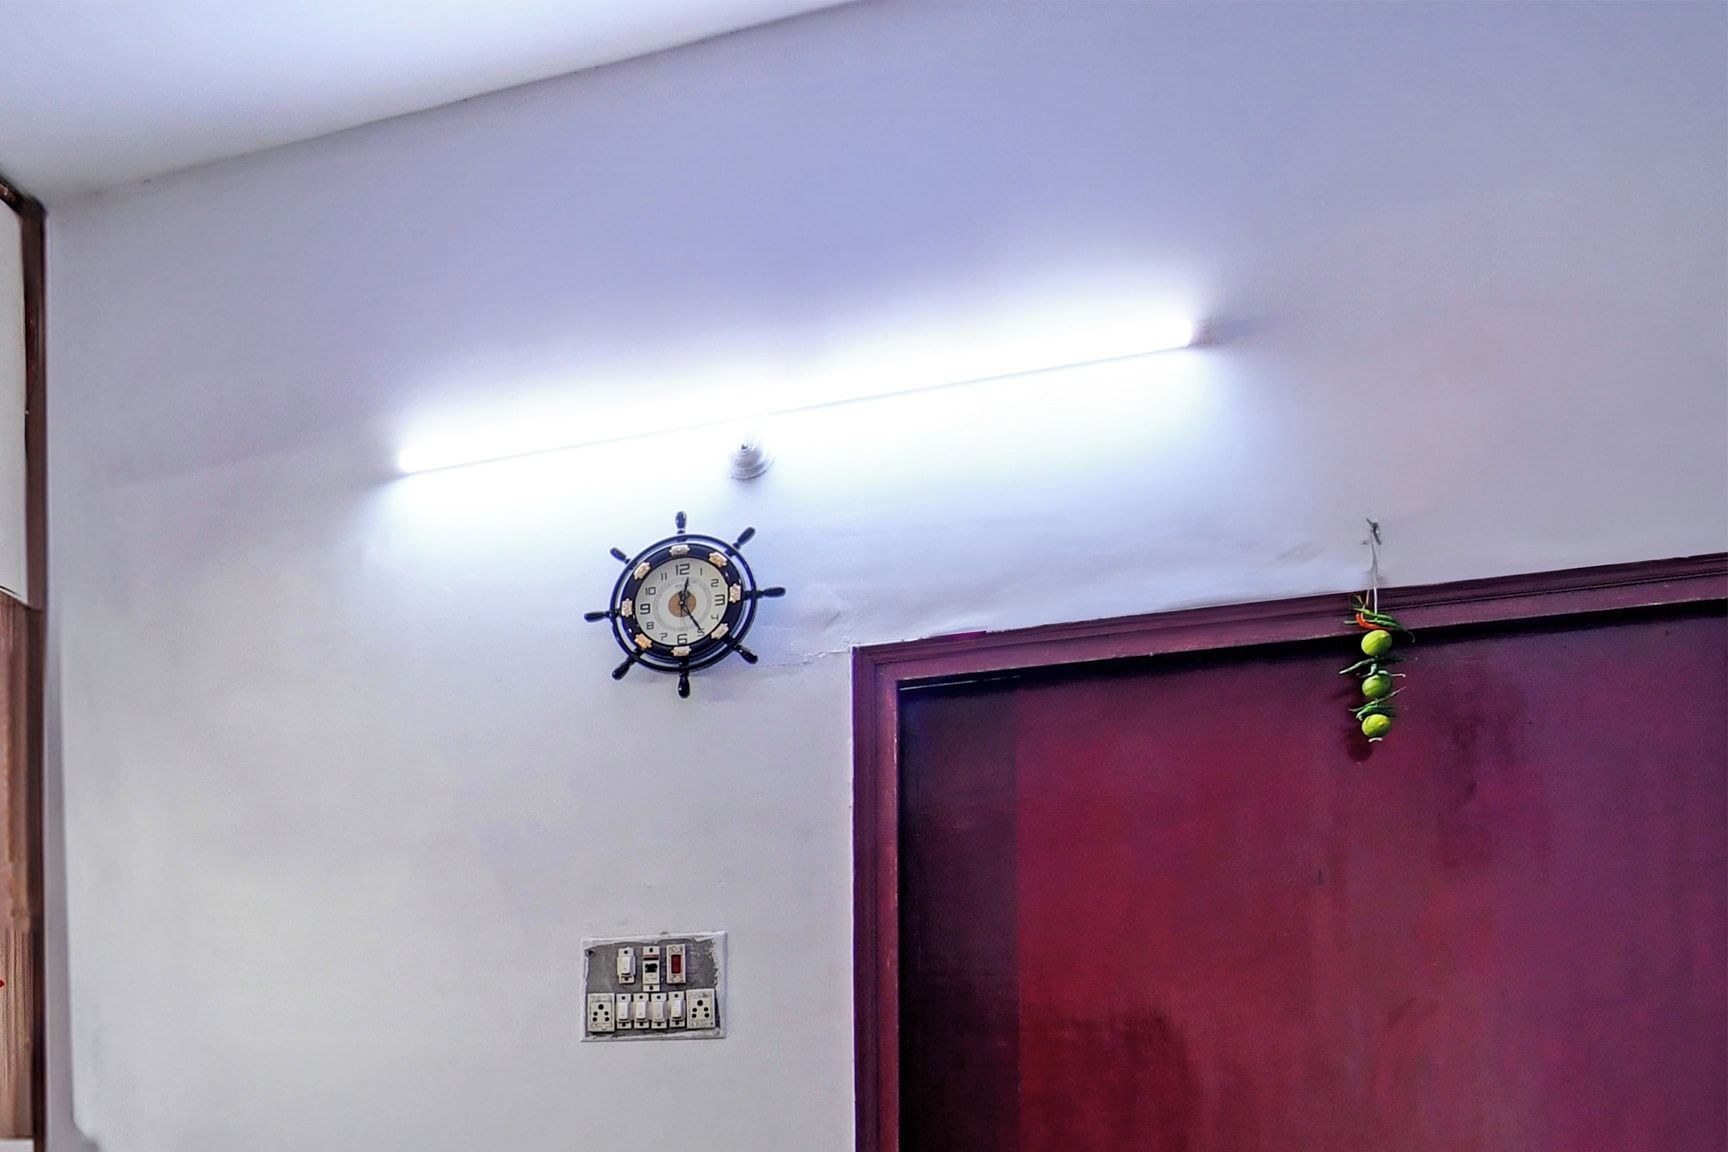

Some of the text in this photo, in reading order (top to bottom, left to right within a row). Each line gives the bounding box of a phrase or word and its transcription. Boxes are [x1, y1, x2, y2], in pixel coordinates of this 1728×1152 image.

[675, 563, 690, 576] 12
[711, 579, 719, 587] 2
[646, 587, 656, 595] 10
[715, 594, 725, 606] 3
[640, 603, 650, 615] 9
[646, 621, 654, 630] 8
[660, 633, 668, 641] 7
[677, 634, 687, 645] 6
